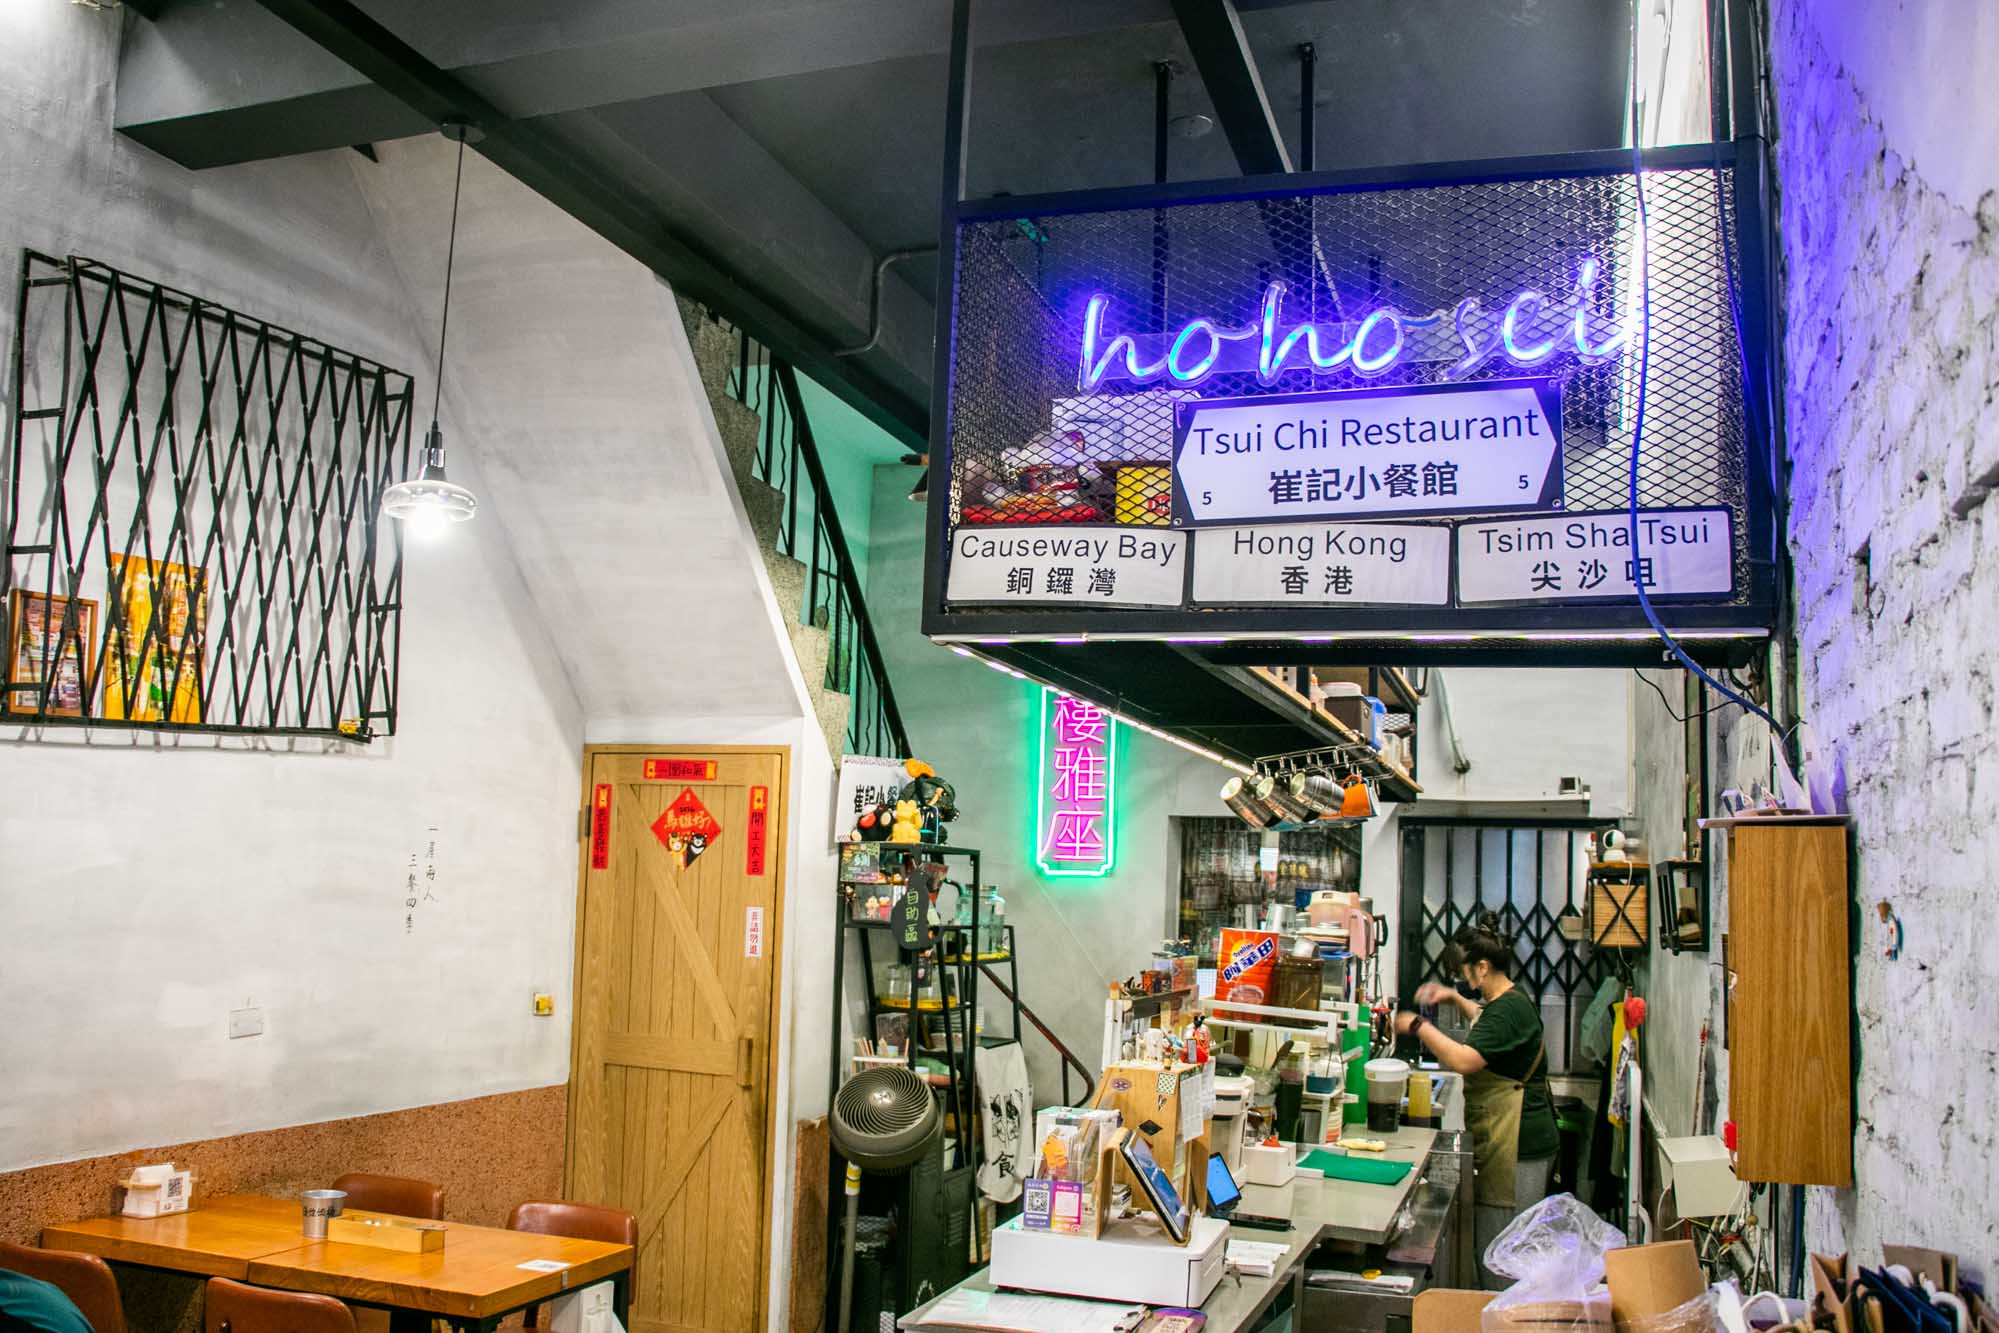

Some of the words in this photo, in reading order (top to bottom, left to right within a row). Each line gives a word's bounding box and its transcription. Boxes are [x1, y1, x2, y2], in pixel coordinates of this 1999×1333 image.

[1193, 424, 1262, 456] Tsui
[1274, 419, 1327, 450] Chi
[1341, 409, 1540, 447] Restaurant
[1202, 491, 1212, 505] 5
[1268, 460, 1459, 504] 崔記小餐館
[1519, 474, 1529, 489] 5
[960, 535, 1109, 564] Causeway
[1118, 534, 1176, 567] Bay
[1233, 530, 1314, 561] Hong
[1325, 530, 1407, 563] Kong
[1478, 527, 1553, 554] Tsim
[1565, 523, 1630, 549] Sha
[1639, 518, 1709, 545] Tsui
[1006, 567, 1116, 596] 銅鑼灣
[1281, 565, 1353, 595] 香港
[1530, 557, 1657, 591] 尖沙咀
[1041, 695, 1108, 862] 樓雅座
